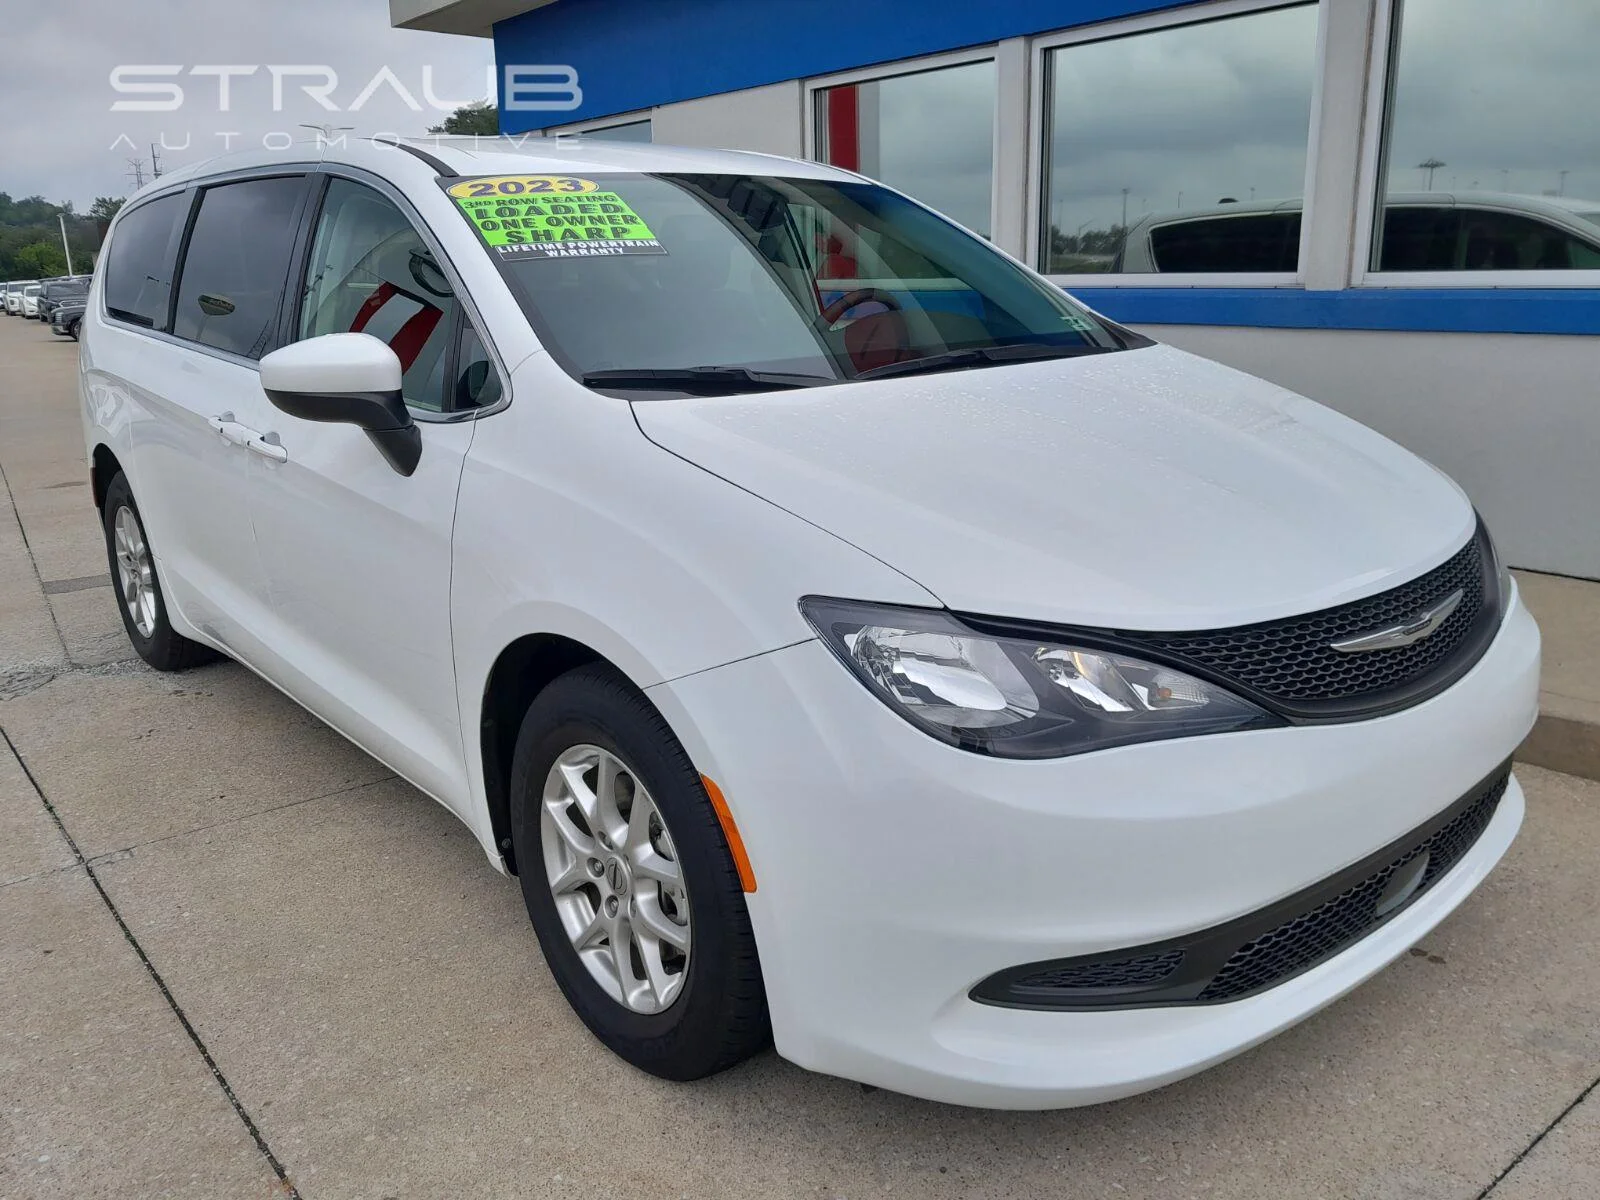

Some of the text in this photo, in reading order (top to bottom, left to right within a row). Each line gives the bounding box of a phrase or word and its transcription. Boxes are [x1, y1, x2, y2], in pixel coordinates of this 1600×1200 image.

[468, 179, 584, 197] 2023
[495, 198, 538, 206] ROW
[541, 194, 618, 204] SEATING
[475, 203, 624, 220] LOADED
[481, 214, 641, 231] ONE OWNER
[505, 226, 631, 244] SHARP
[497, 240, 660, 253] LIFETIME POWERTRAIN
[546, 247, 624, 257] WARRANTY
